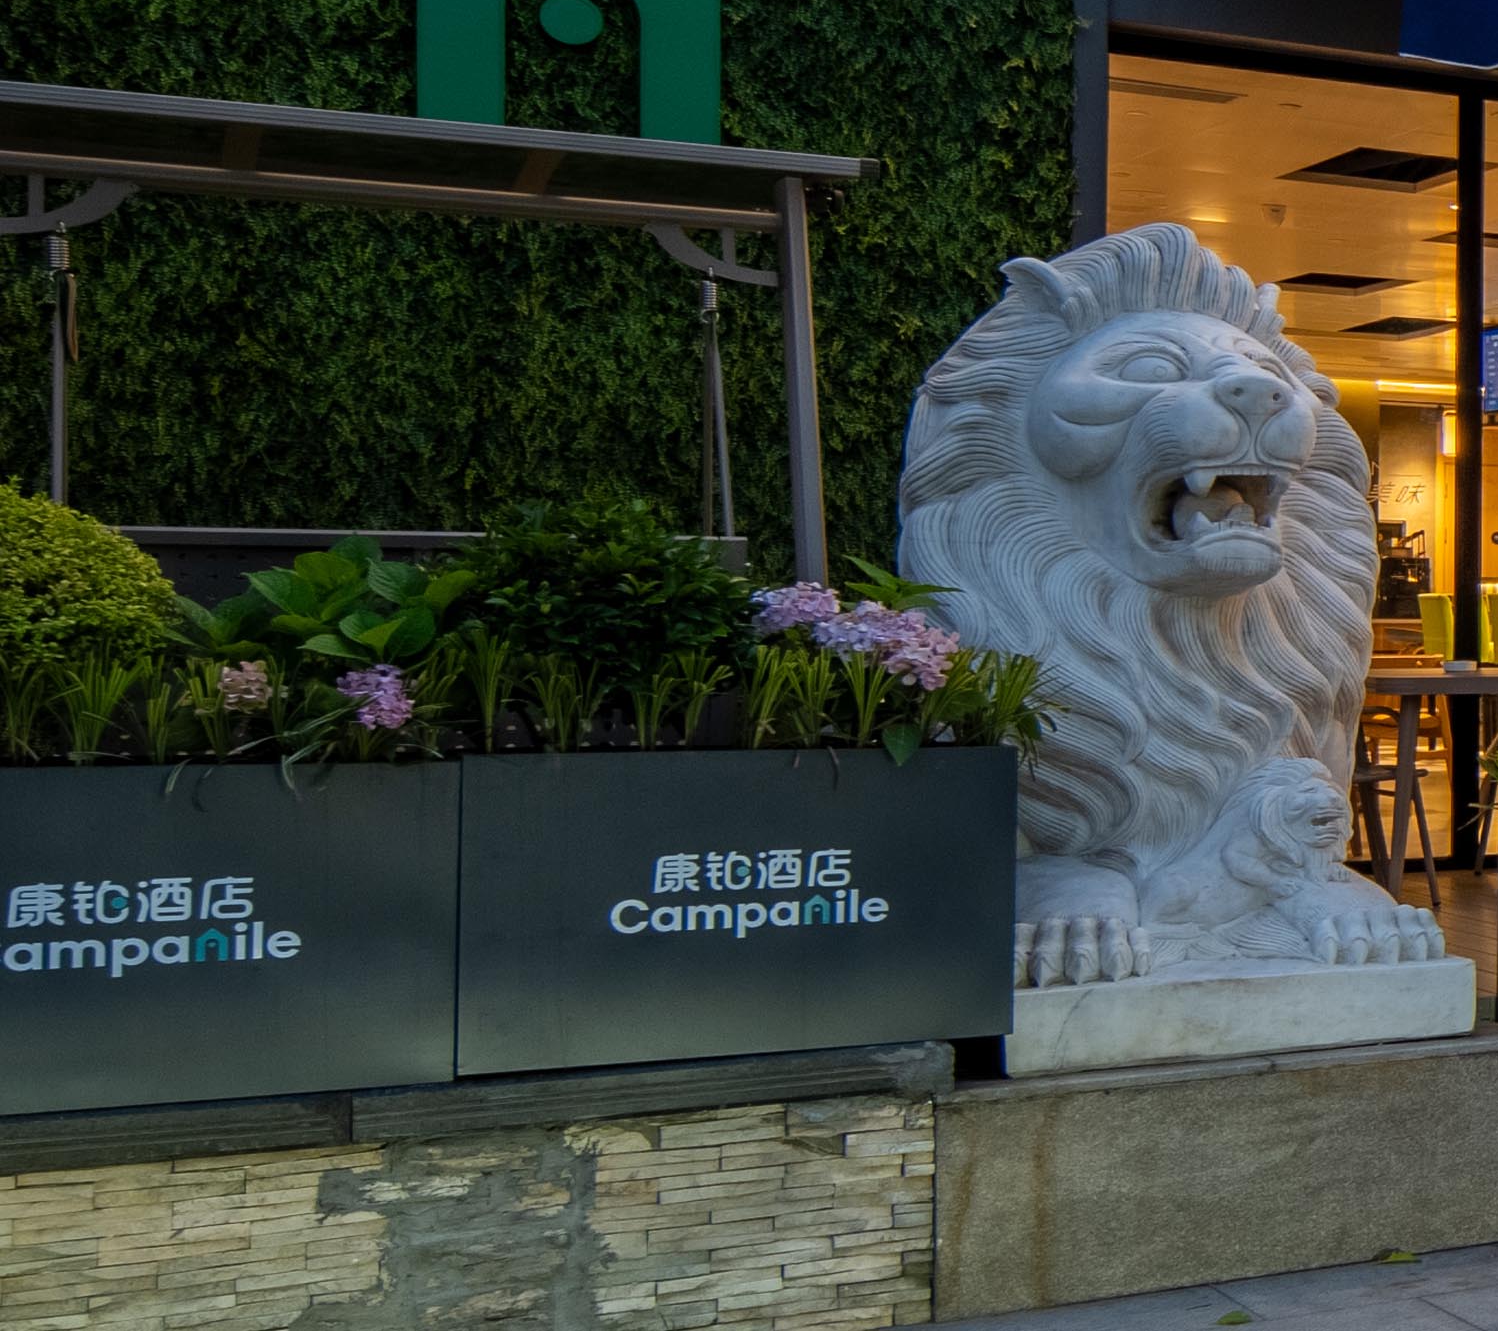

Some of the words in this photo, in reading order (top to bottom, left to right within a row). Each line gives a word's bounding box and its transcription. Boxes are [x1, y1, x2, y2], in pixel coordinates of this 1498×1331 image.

[654, 848, 851, 894] 康铂酒店
[7, 876, 254, 928] 康铂酒店
[610, 889, 890, 938] Campanile
[0, 921, 302, 978] ampanile
